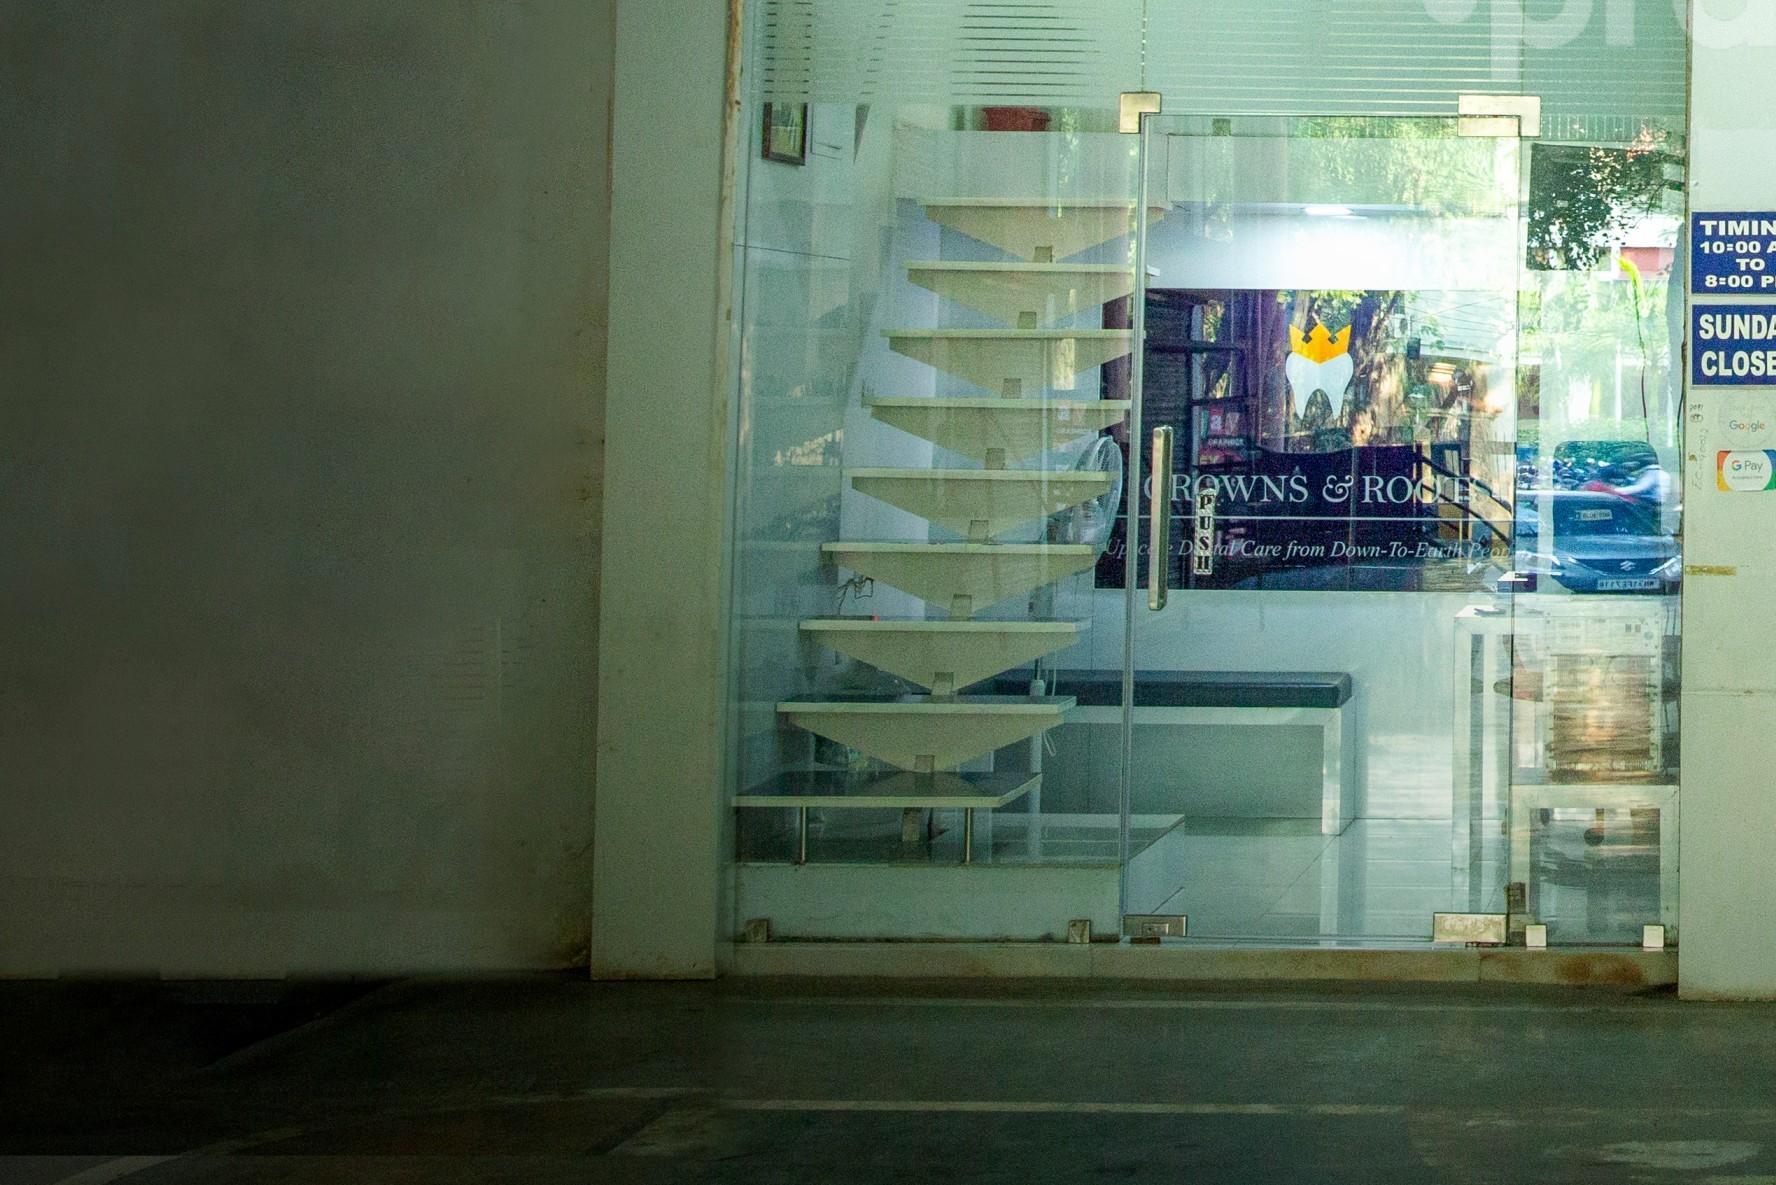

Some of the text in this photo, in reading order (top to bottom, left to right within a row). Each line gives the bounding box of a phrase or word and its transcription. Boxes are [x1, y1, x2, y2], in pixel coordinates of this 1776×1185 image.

[1699, 241, 1761, 254] 10:00
[1736, 258, 1766, 271] TO
[1704, 275, 1754, 288] 8:00
[1744, 460, 1763, 472] Pay
[1322, 474, 1354, 503] &
[1361, 475, 1480, 504] ROOT
[1241, 539, 1282, 557] Care
[1282, 539, 1325, 561] from
